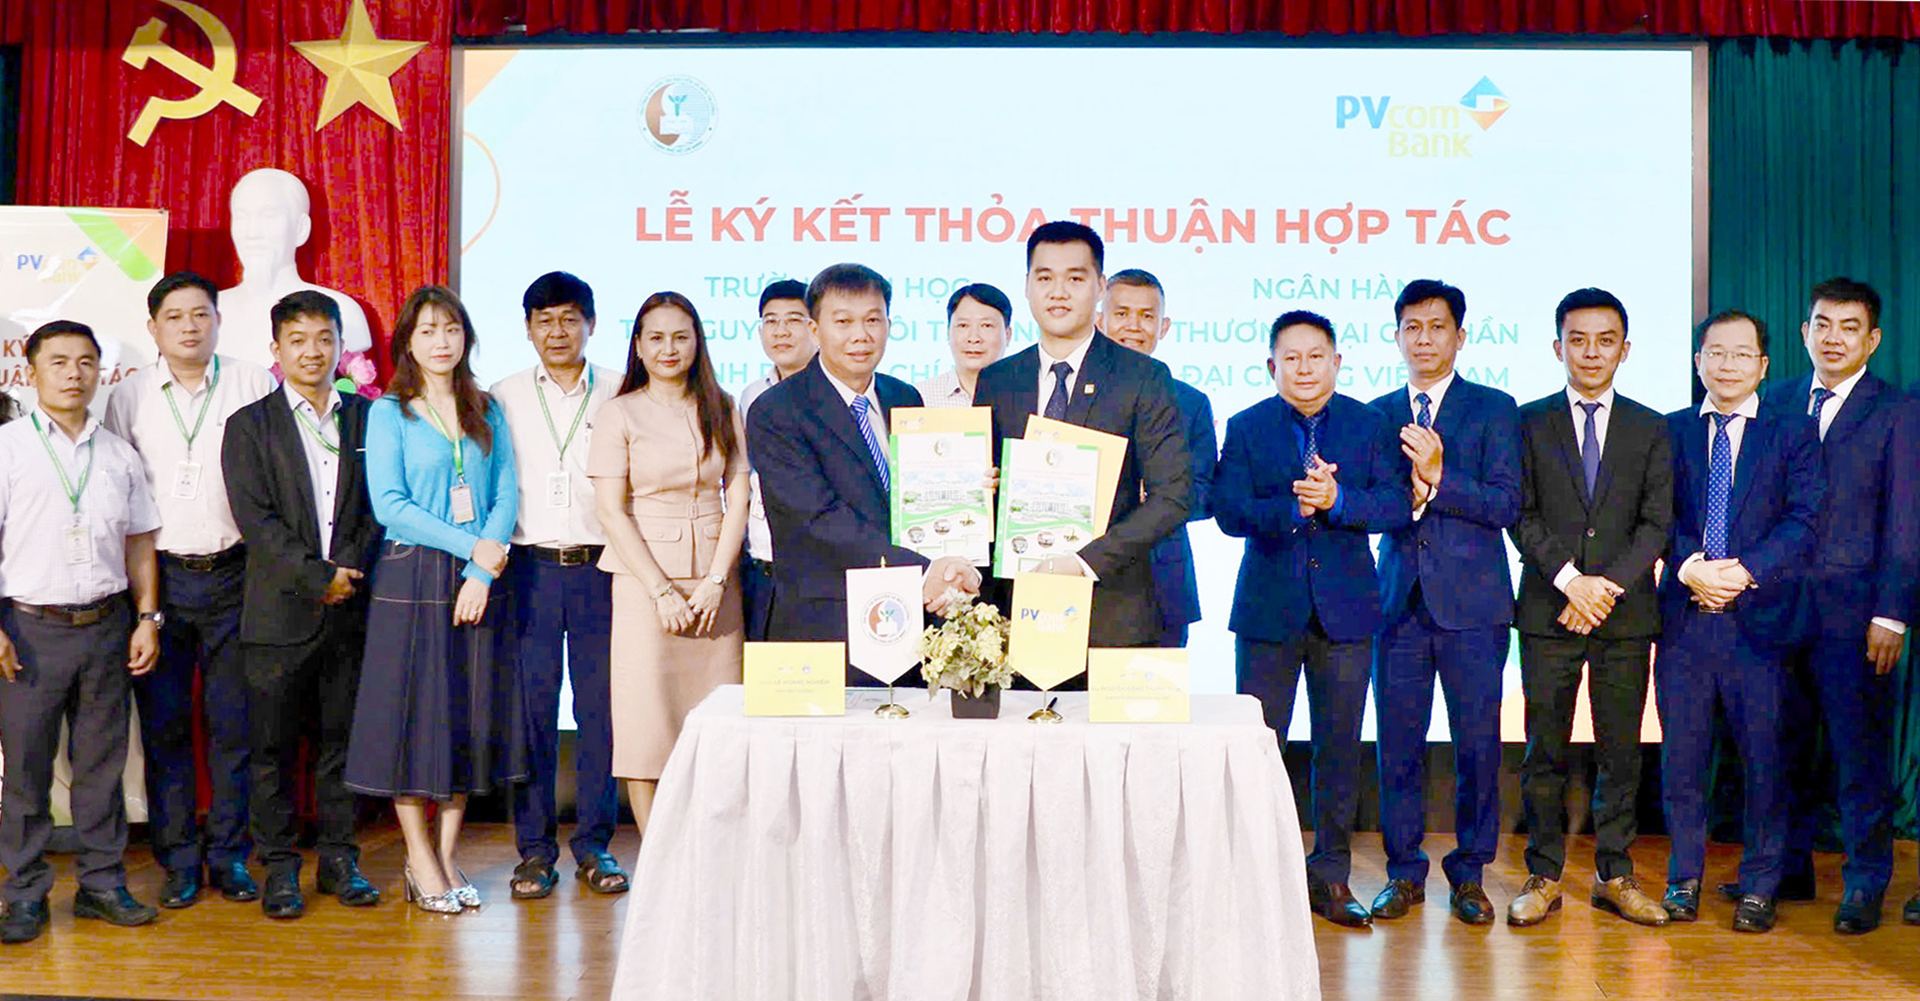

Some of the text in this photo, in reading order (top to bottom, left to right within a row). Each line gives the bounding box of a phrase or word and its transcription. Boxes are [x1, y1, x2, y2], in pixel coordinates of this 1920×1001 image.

[1387, 131, 1473, 158] Bank
[636, 190, 693, 242] LỄ
[711, 197, 776, 242] KÝ
[793, 193, 890, 242] KẾT
[1275, 202, 1390, 254] HỢP
[1405, 199, 1512, 245] TÁC
[1253, 272, 1406, 300] NGÂN HÀ
[889, 315, 917, 341] ÔI
[1171, 317, 1270, 344] THƯƠ
[1334, 322, 1368, 350] ẠI
[1179, 365, 1232, 392] ĐẠI
